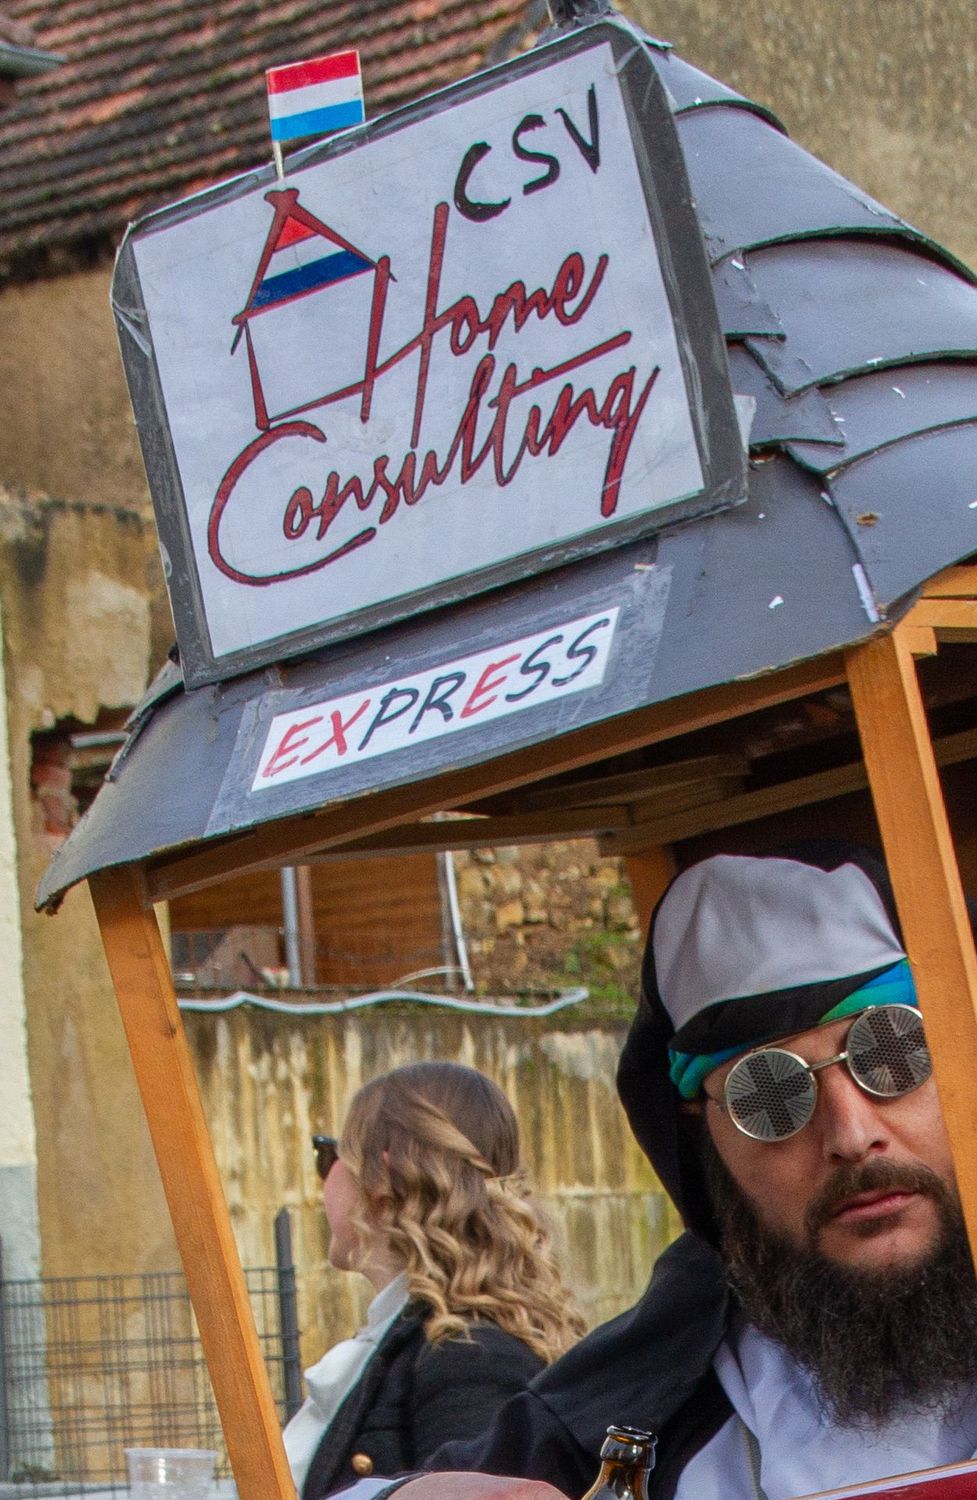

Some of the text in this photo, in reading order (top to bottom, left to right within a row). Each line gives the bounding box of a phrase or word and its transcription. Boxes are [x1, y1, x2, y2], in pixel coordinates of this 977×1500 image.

[453, 82, 601, 222] CSV
[360, 203, 609, 448] Home
[207, 331, 660, 587] Consulting
[262, 617, 610, 778] EXPRESS
